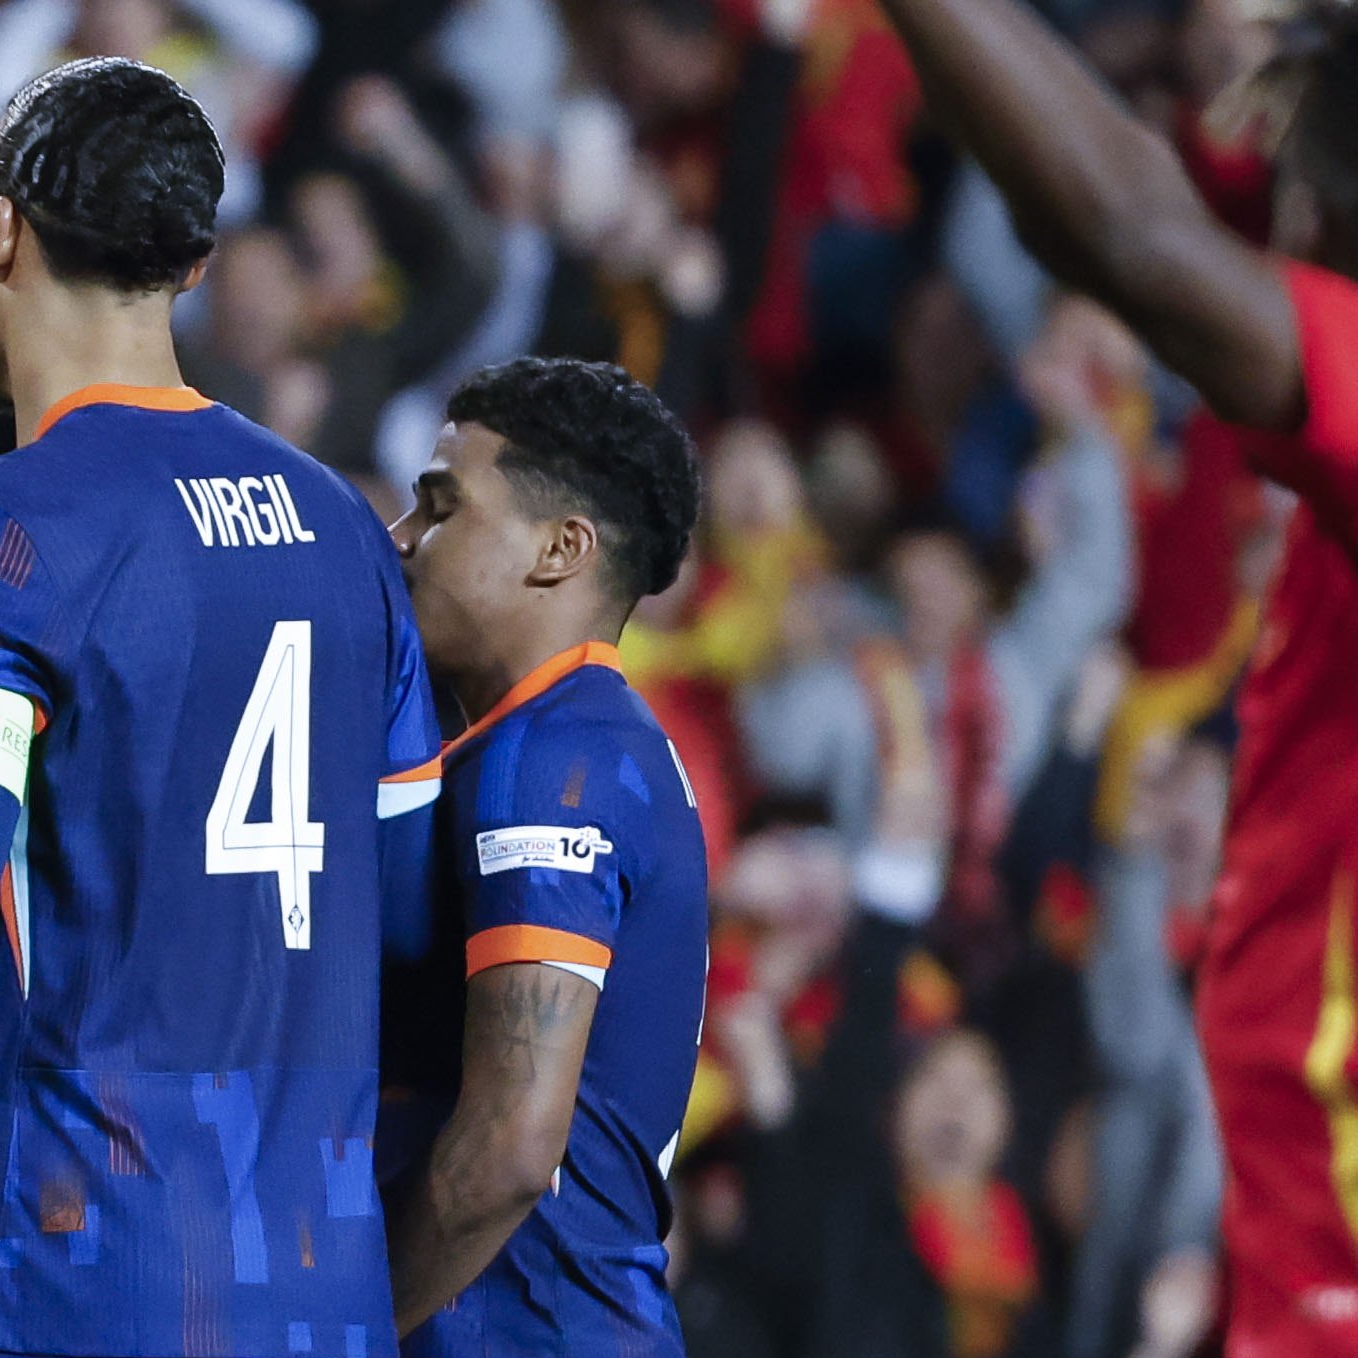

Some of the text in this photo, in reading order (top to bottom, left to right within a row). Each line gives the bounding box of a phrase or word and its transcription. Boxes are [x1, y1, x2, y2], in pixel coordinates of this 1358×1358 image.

[175, 474, 316, 548] VIRGIL
[205, 620, 325, 949] 4
[559, 836, 591, 859] 10
